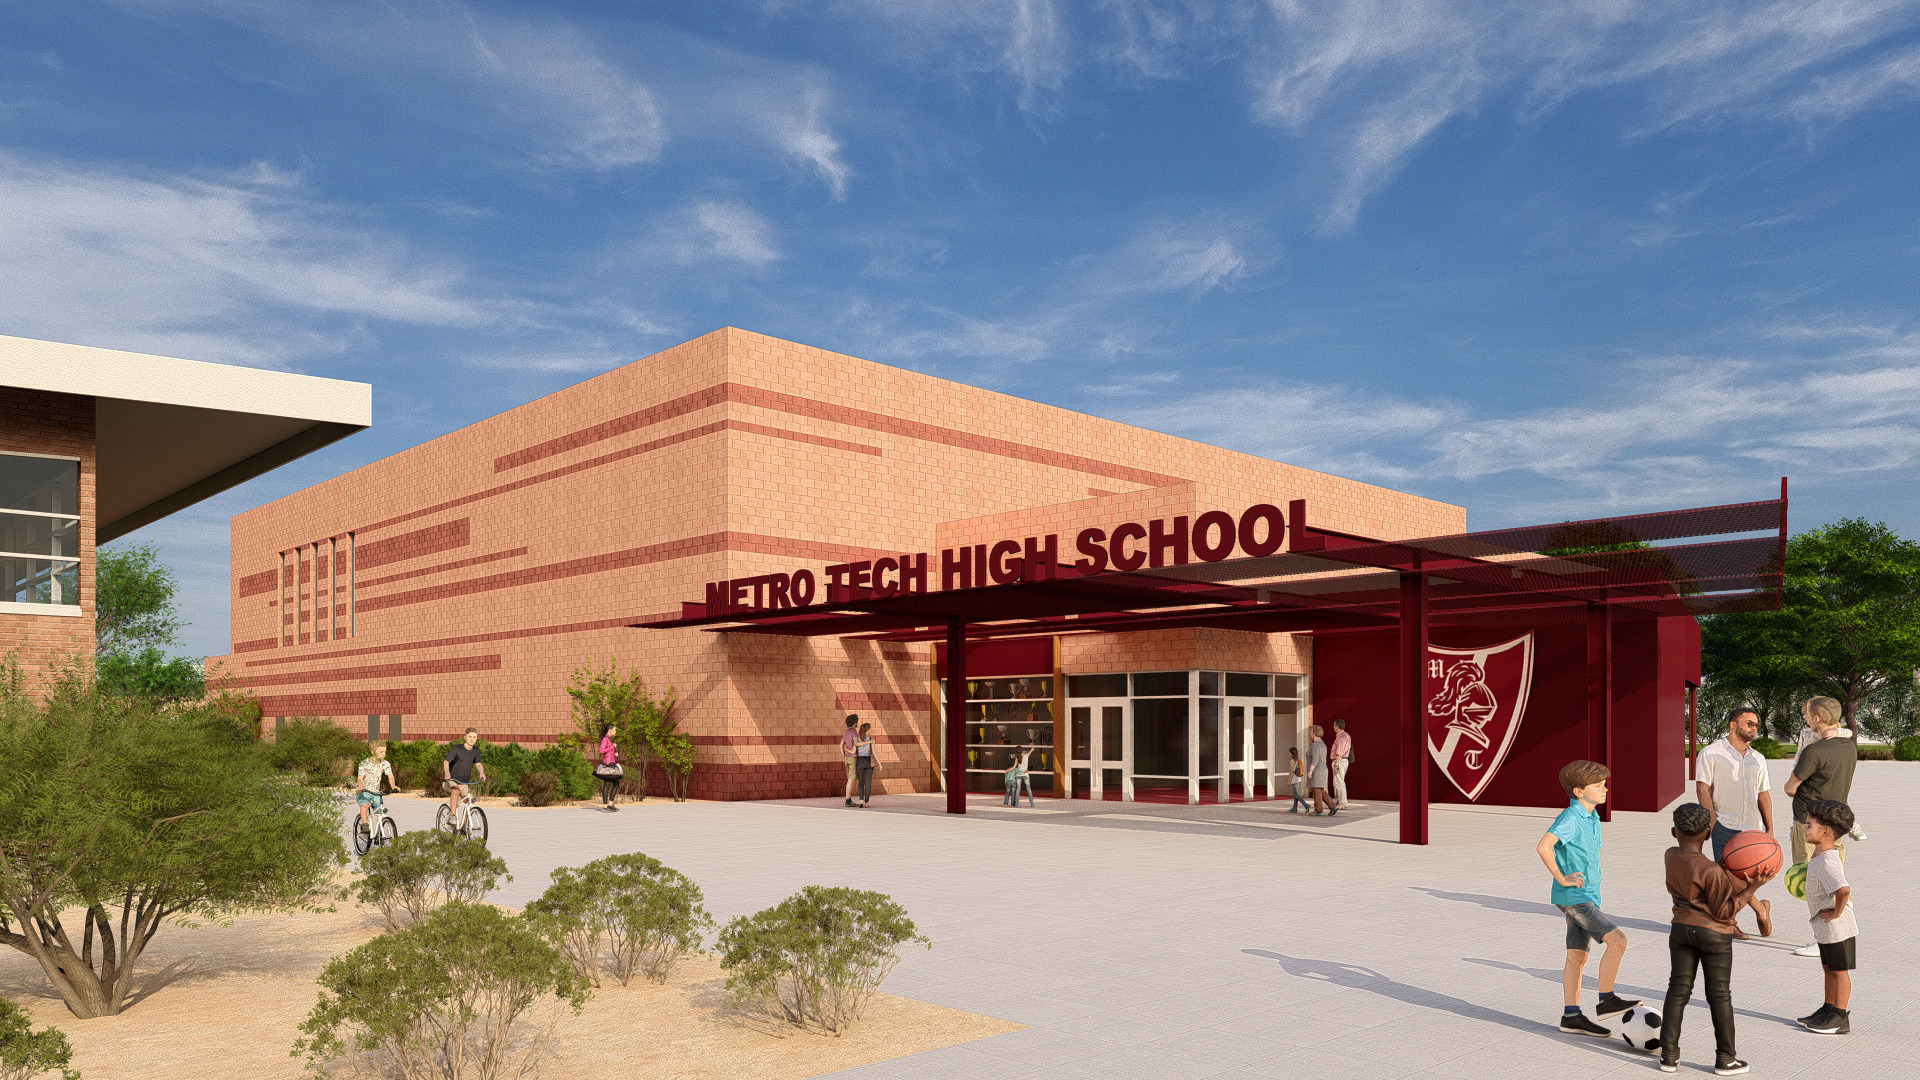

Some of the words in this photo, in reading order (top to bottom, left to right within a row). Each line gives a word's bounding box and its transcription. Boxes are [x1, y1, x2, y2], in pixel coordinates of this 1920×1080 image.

[705, 569, 816, 617] METRO
[824, 552, 928, 603] TECH
[941, 534, 1058, 591] HIGH
[1075, 498, 1327, 576] SCHOOL
[1427, 658, 1445, 679] M
[1463, 749, 1484, 770] T
